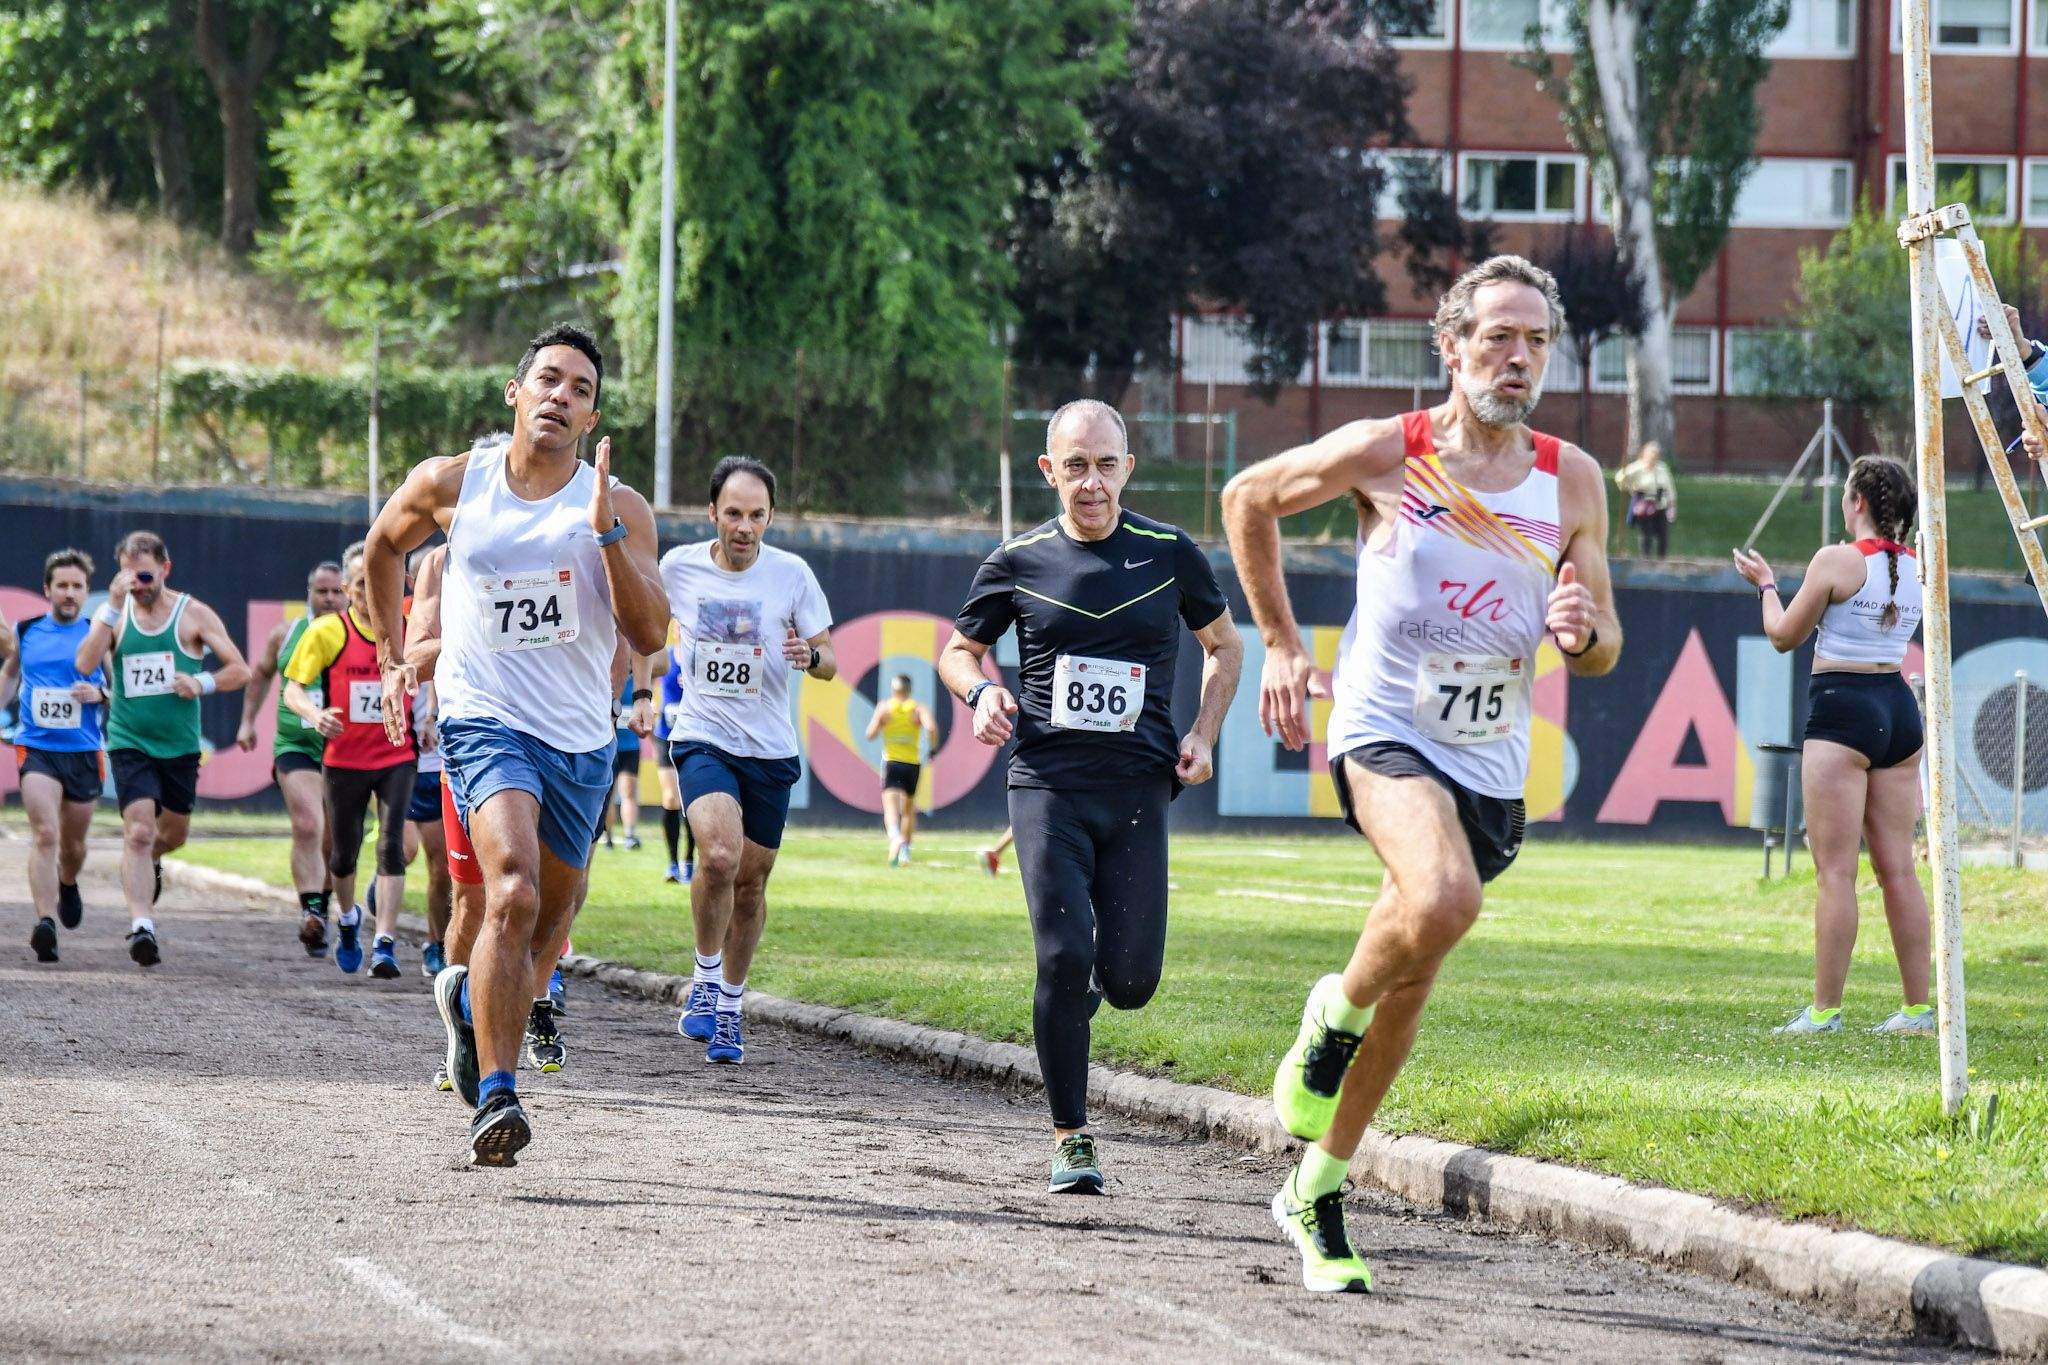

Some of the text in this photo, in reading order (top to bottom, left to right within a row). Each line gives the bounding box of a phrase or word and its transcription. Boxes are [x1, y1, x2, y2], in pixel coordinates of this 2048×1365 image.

[494, 594, 562, 634] 734
[1852, 600, 1878, 610] MAD
[557, 629, 576, 640] 2023
[131, 667, 166, 686] 724
[706, 660, 751, 686] 828
[360, 696, 382, 713] 74
[1066, 681, 1127, 716] 836
[1438, 684, 1505, 723] 715
[40, 702, 73, 719] 829
